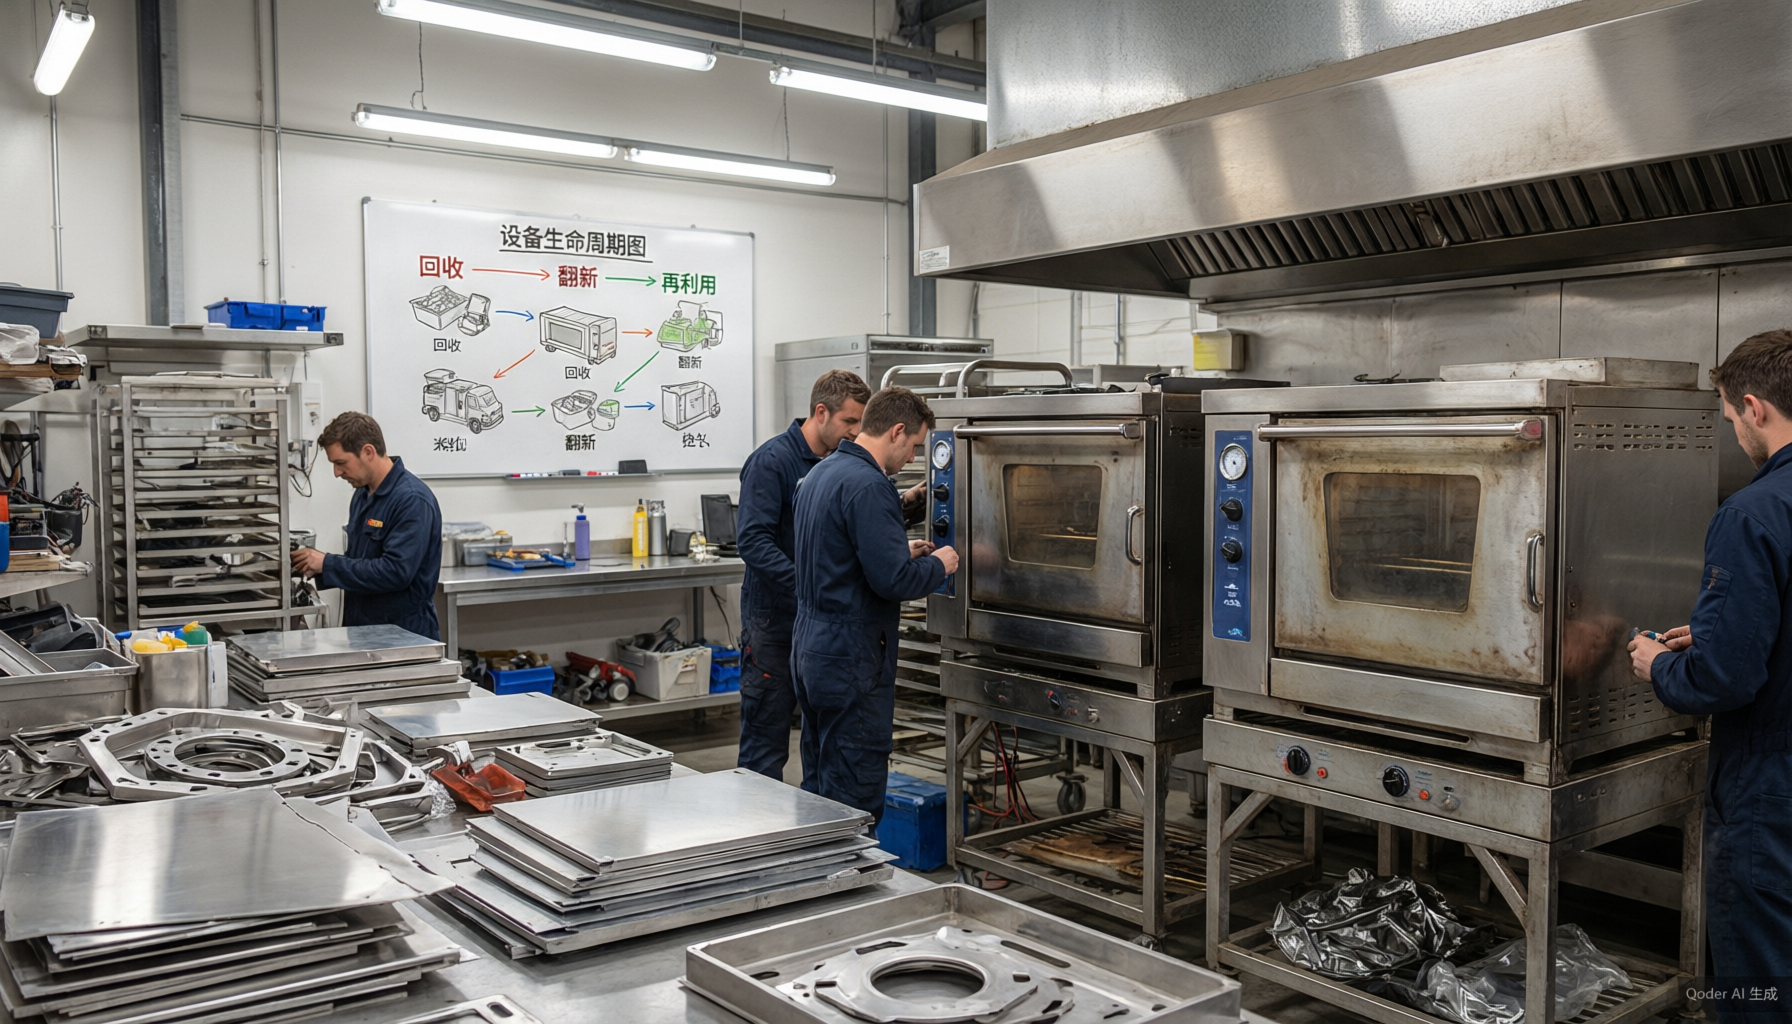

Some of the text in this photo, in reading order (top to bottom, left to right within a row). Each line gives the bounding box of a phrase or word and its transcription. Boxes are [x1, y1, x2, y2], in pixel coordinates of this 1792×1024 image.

[499, 224, 647, 258] 设备生命周期图
[419, 254, 717, 296] 回收 翻新 再利用
[433, 338, 462, 353] 回收
[564, 366, 592, 380] 回收
